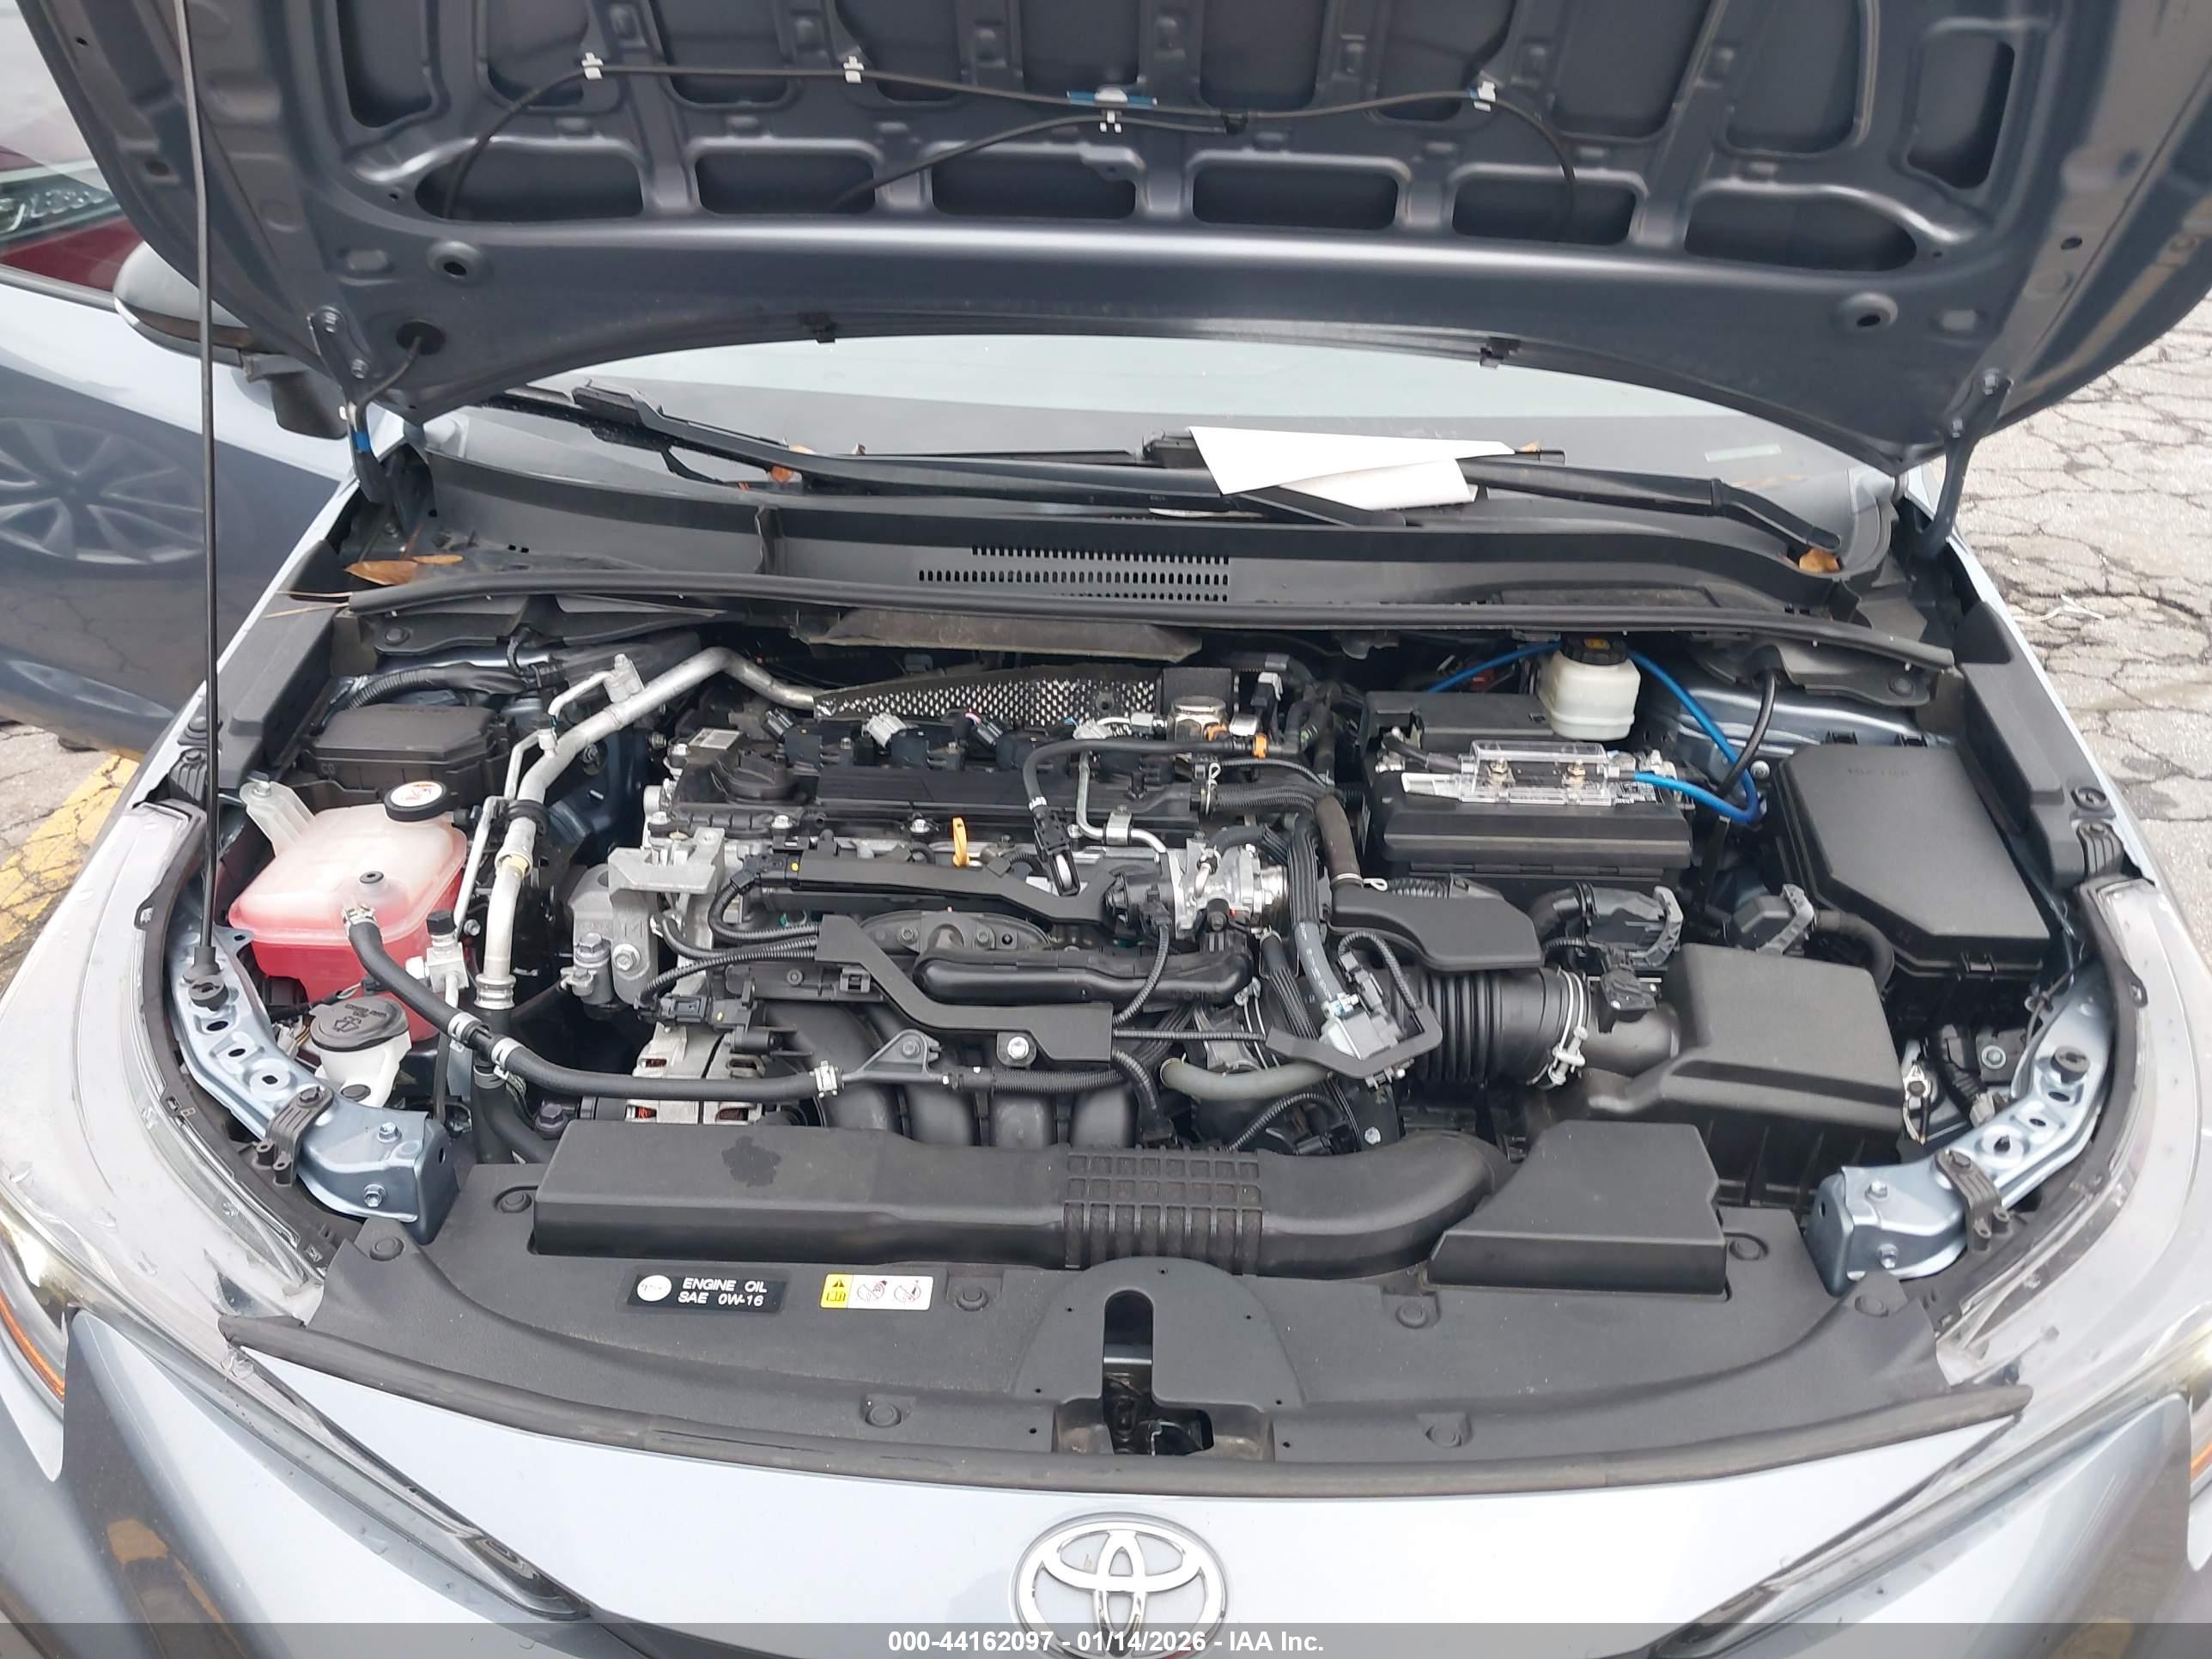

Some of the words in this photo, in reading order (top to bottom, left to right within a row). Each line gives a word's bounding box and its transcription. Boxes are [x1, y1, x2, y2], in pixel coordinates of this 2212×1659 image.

[683, 1278, 737, 1291] ENGINE
[744, 1280, 768, 1293] OIL
[678, 1291, 709, 1304] SAE
[718, 1293, 764, 1307] 0W-16
